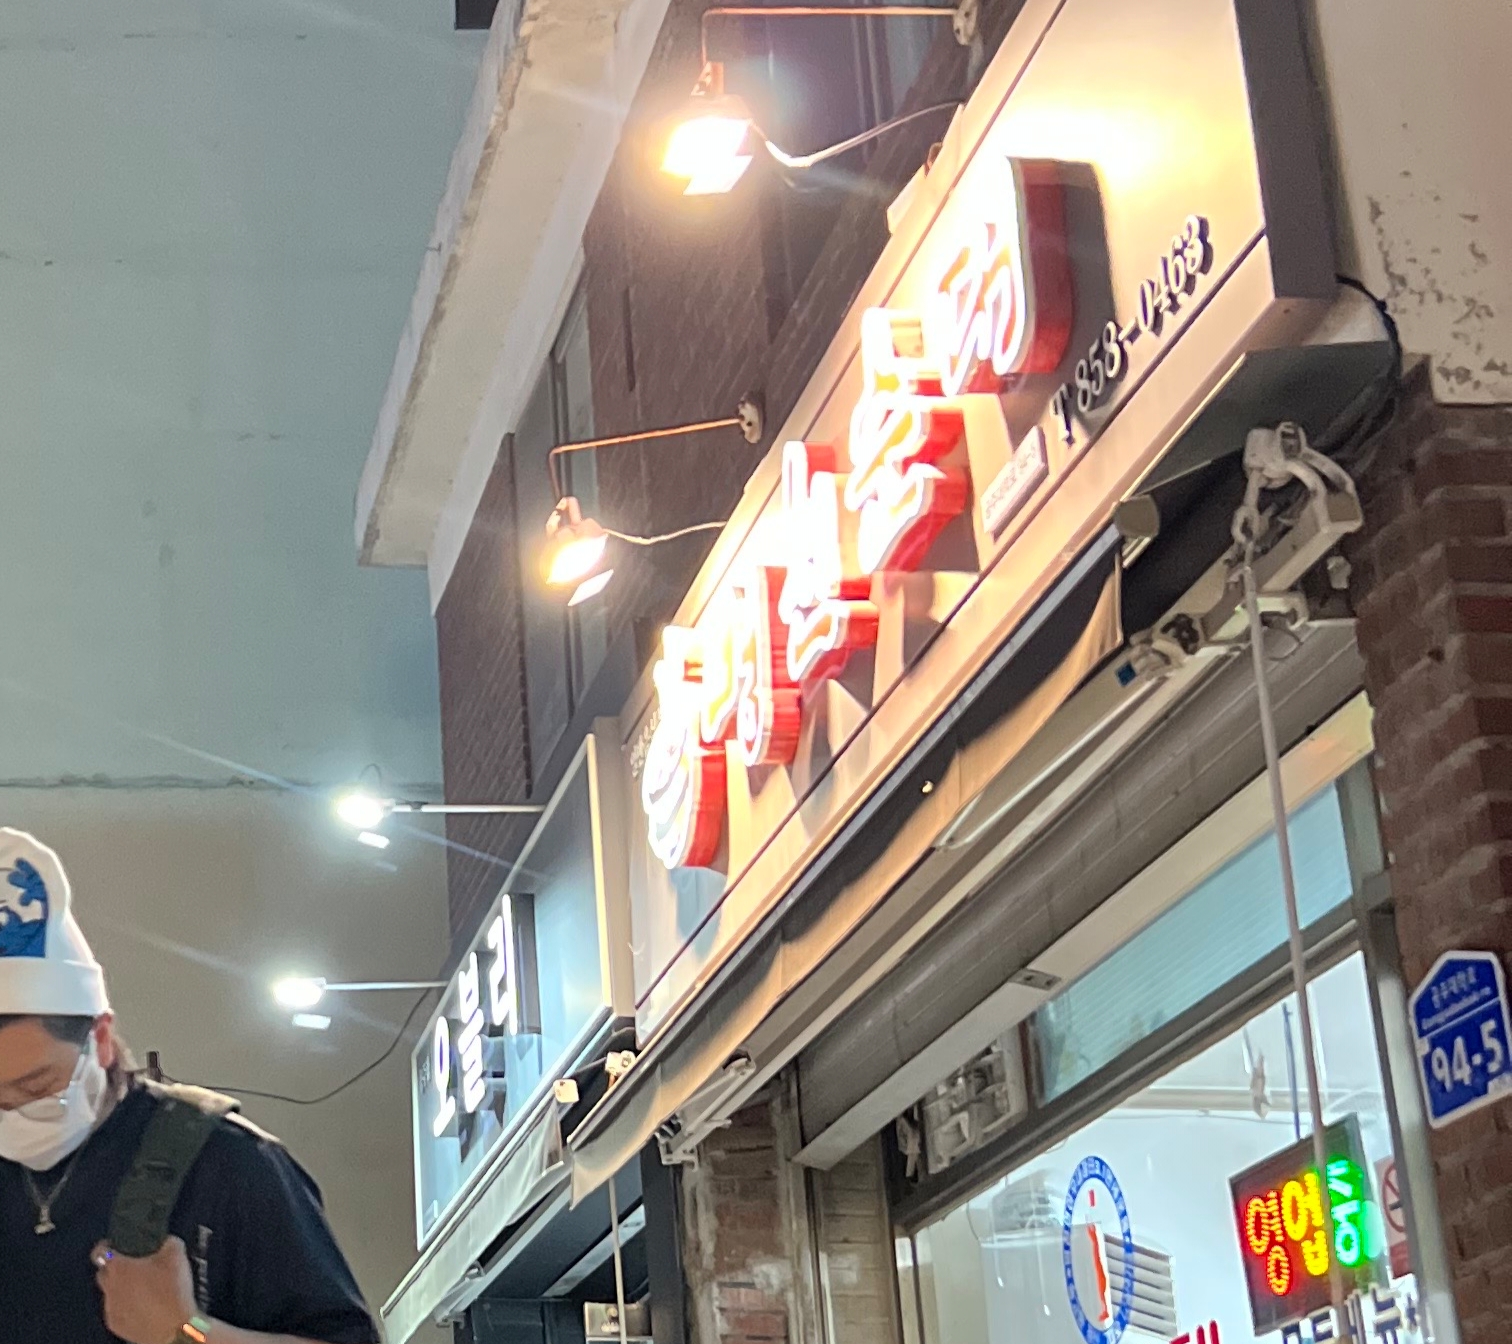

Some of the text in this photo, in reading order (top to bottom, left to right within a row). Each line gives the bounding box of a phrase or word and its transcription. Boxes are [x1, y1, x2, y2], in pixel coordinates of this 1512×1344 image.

[1075, 214, 1210, 411] 858-0463
[433, 893, 518, 1137] 오블리
[1431, 1019, 1503, 1093] 94-5
